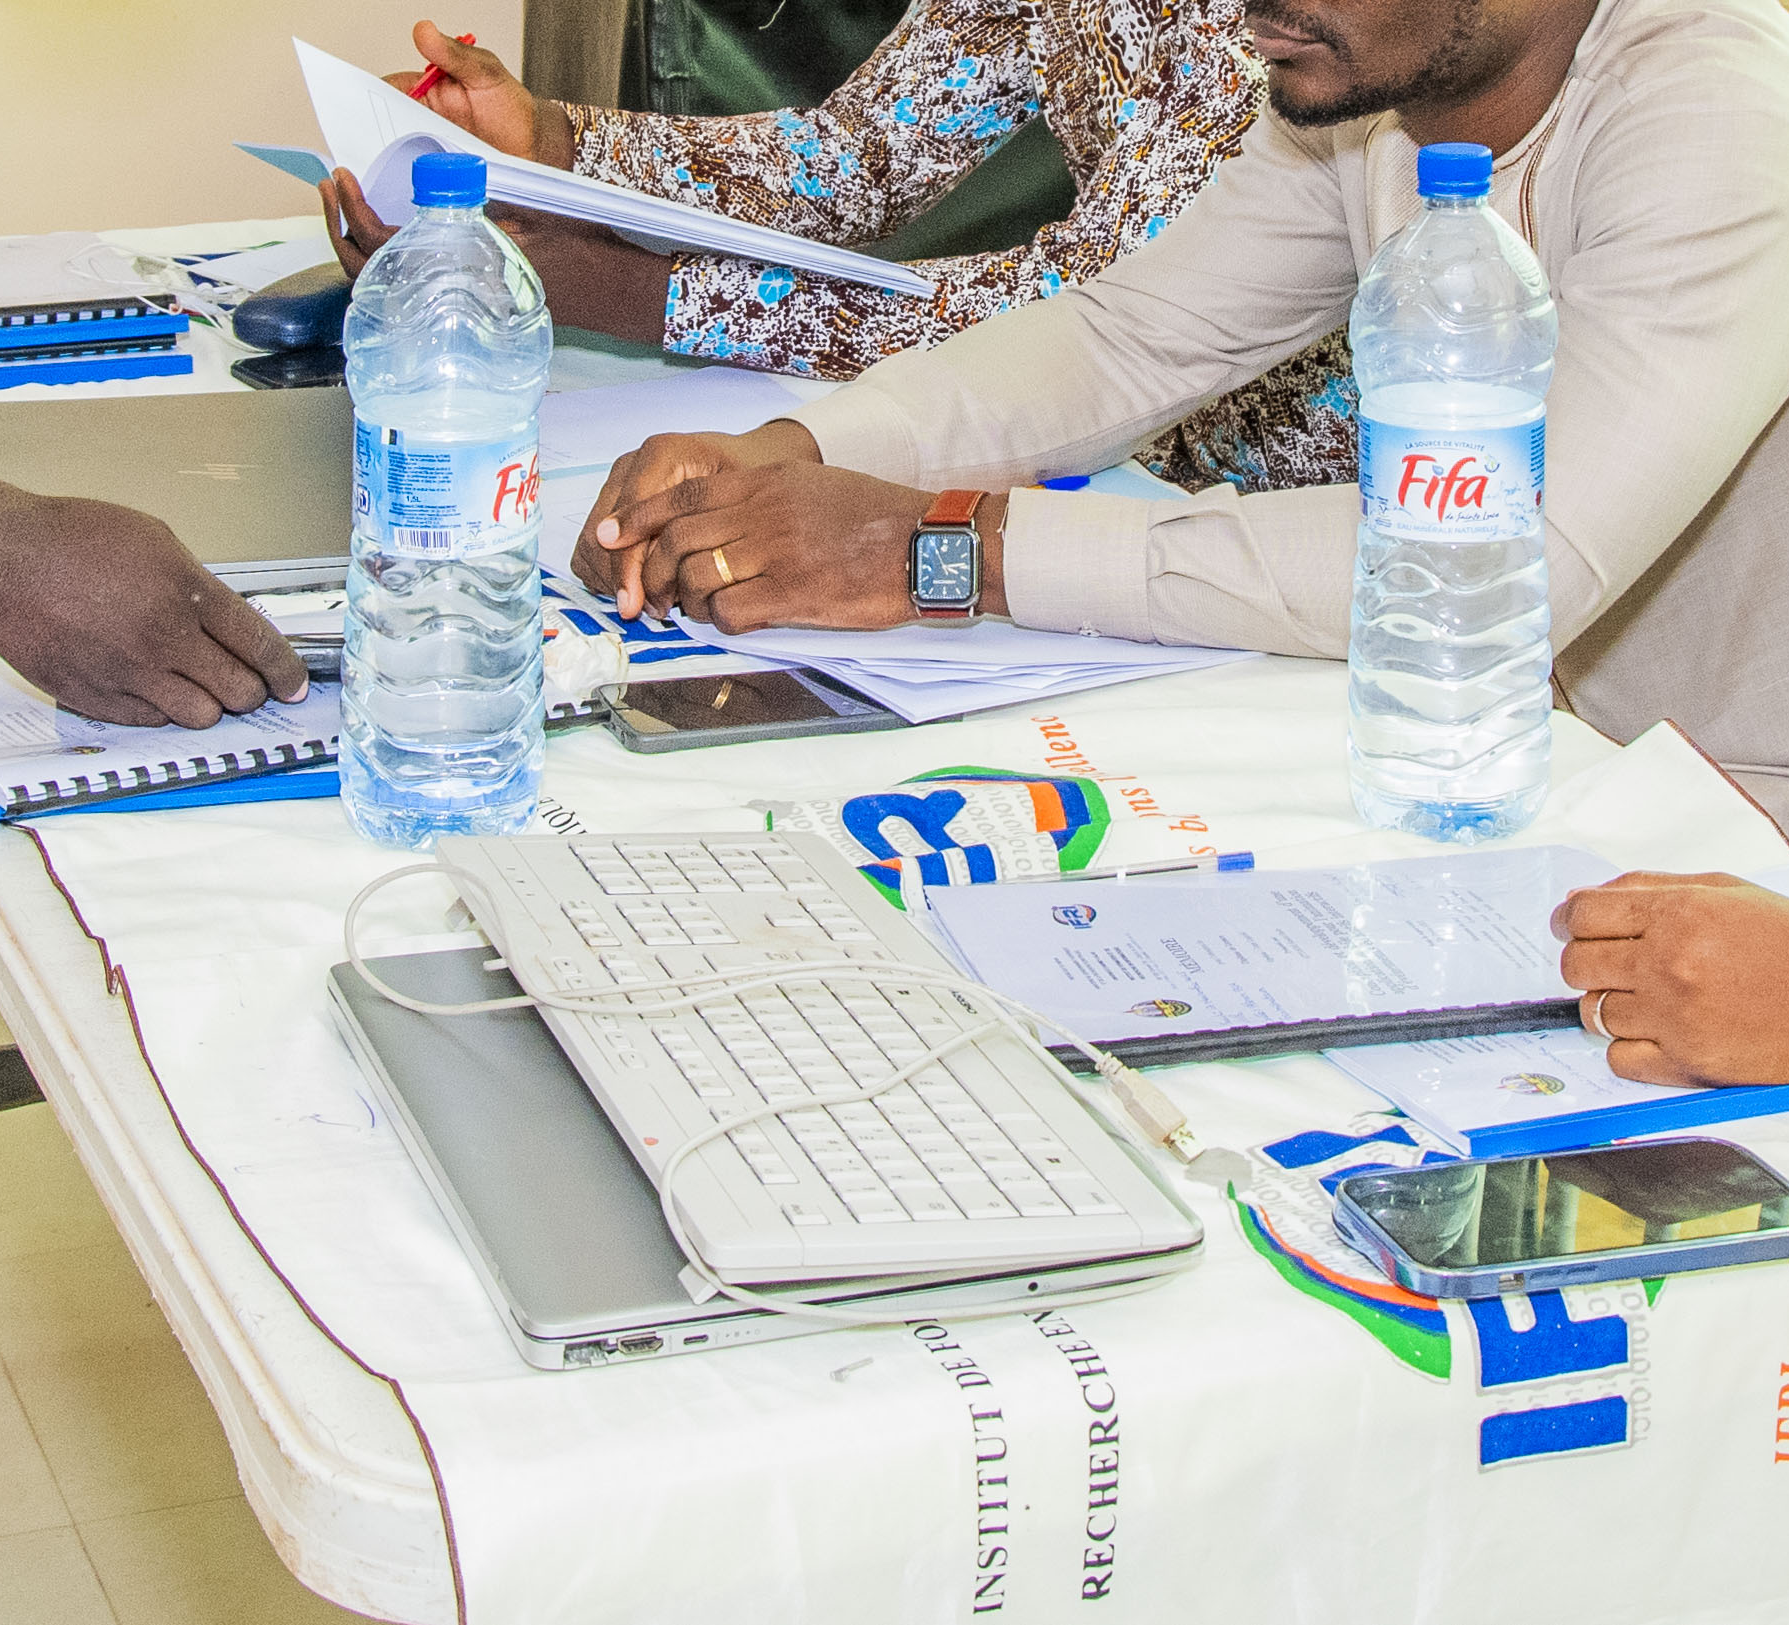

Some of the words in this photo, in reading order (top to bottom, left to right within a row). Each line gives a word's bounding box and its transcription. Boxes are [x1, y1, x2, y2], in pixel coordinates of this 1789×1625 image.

[1398, 454, 1489, 524] Fifa
[941, 1356, 994, 1391] DE
[969, 1402, 1009, 1615] INSTITUT
[1055, 1339, 1121, 1600] RECHERCHE
